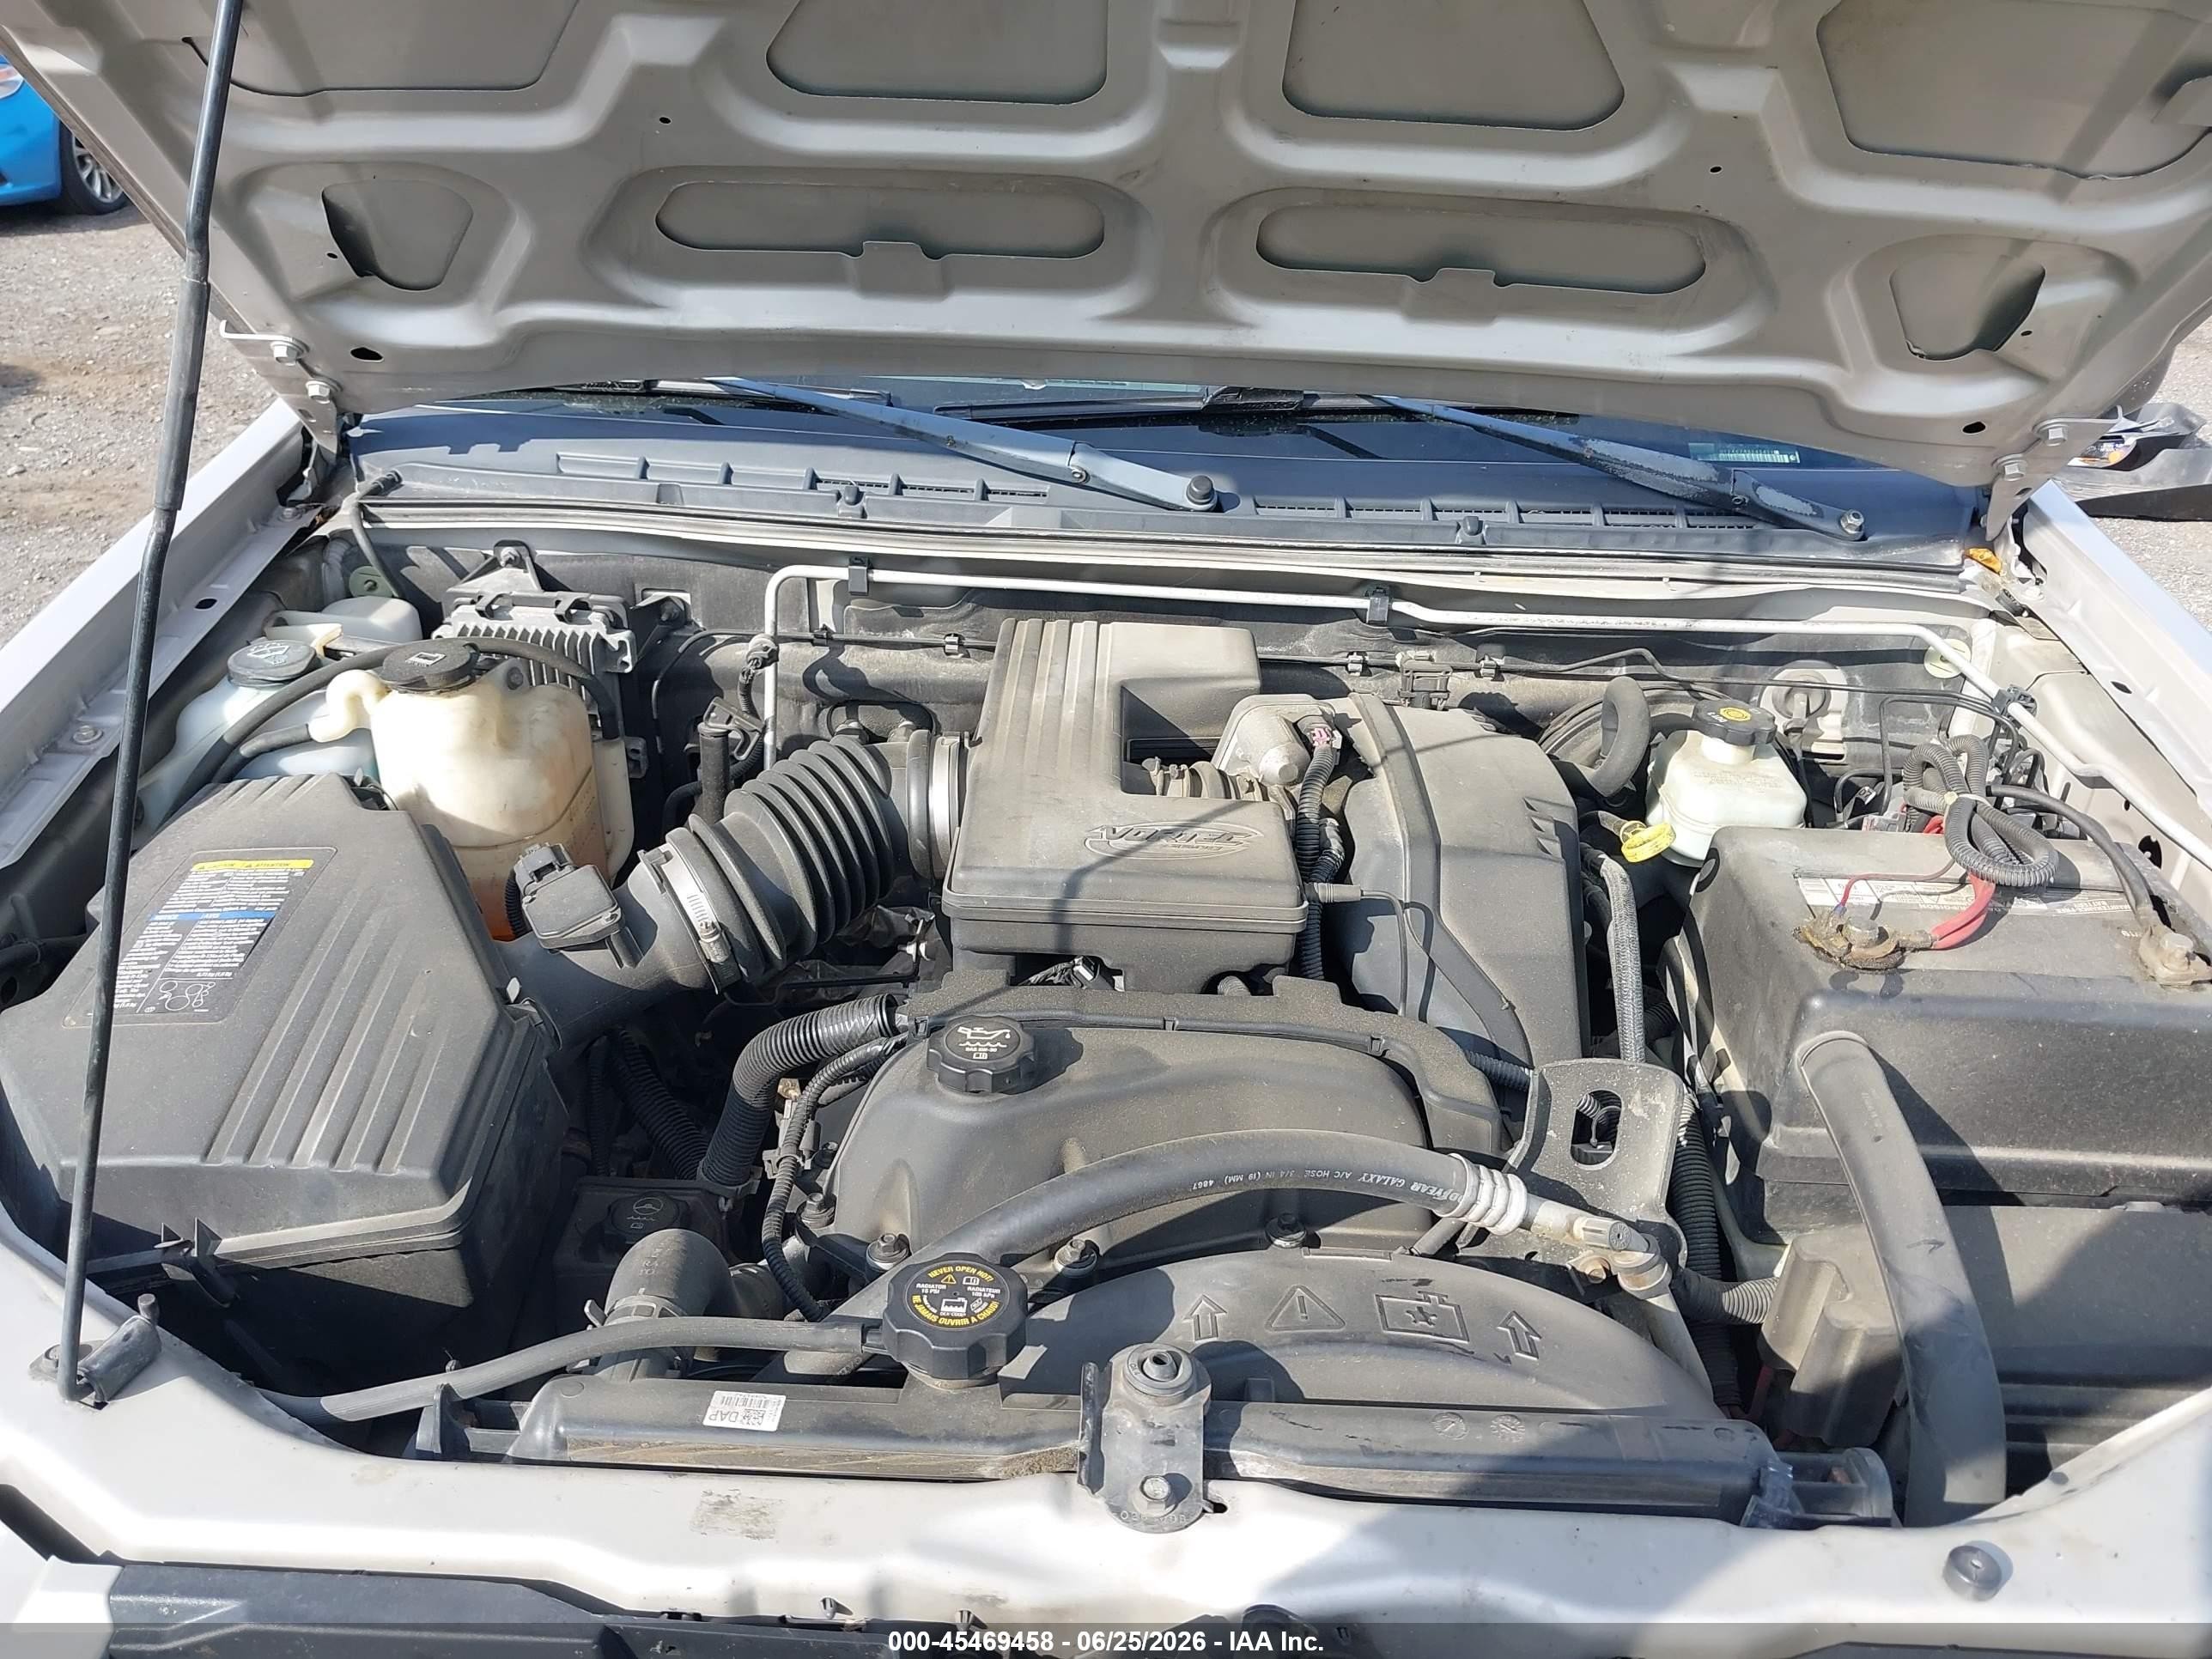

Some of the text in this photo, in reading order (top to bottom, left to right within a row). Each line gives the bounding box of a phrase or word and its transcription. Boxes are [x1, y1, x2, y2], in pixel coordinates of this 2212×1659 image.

[1105, 825, 1254, 846] VORTEC
[1304, 1170, 1330, 1179] HOSE
[1334, 1170, 1352, 1179] A/C
[1358, 1172, 1406, 1188] GALAXY
[928, 1265, 994, 1283] NEVER OPEN HOT!
[914, 1302, 939, 1322] JAMAIS
[939, 1317, 970, 1326] OUVRIR
[978, 1300, 1000, 1321] CHAUD!
[708, 1409, 739, 1423] DAP
